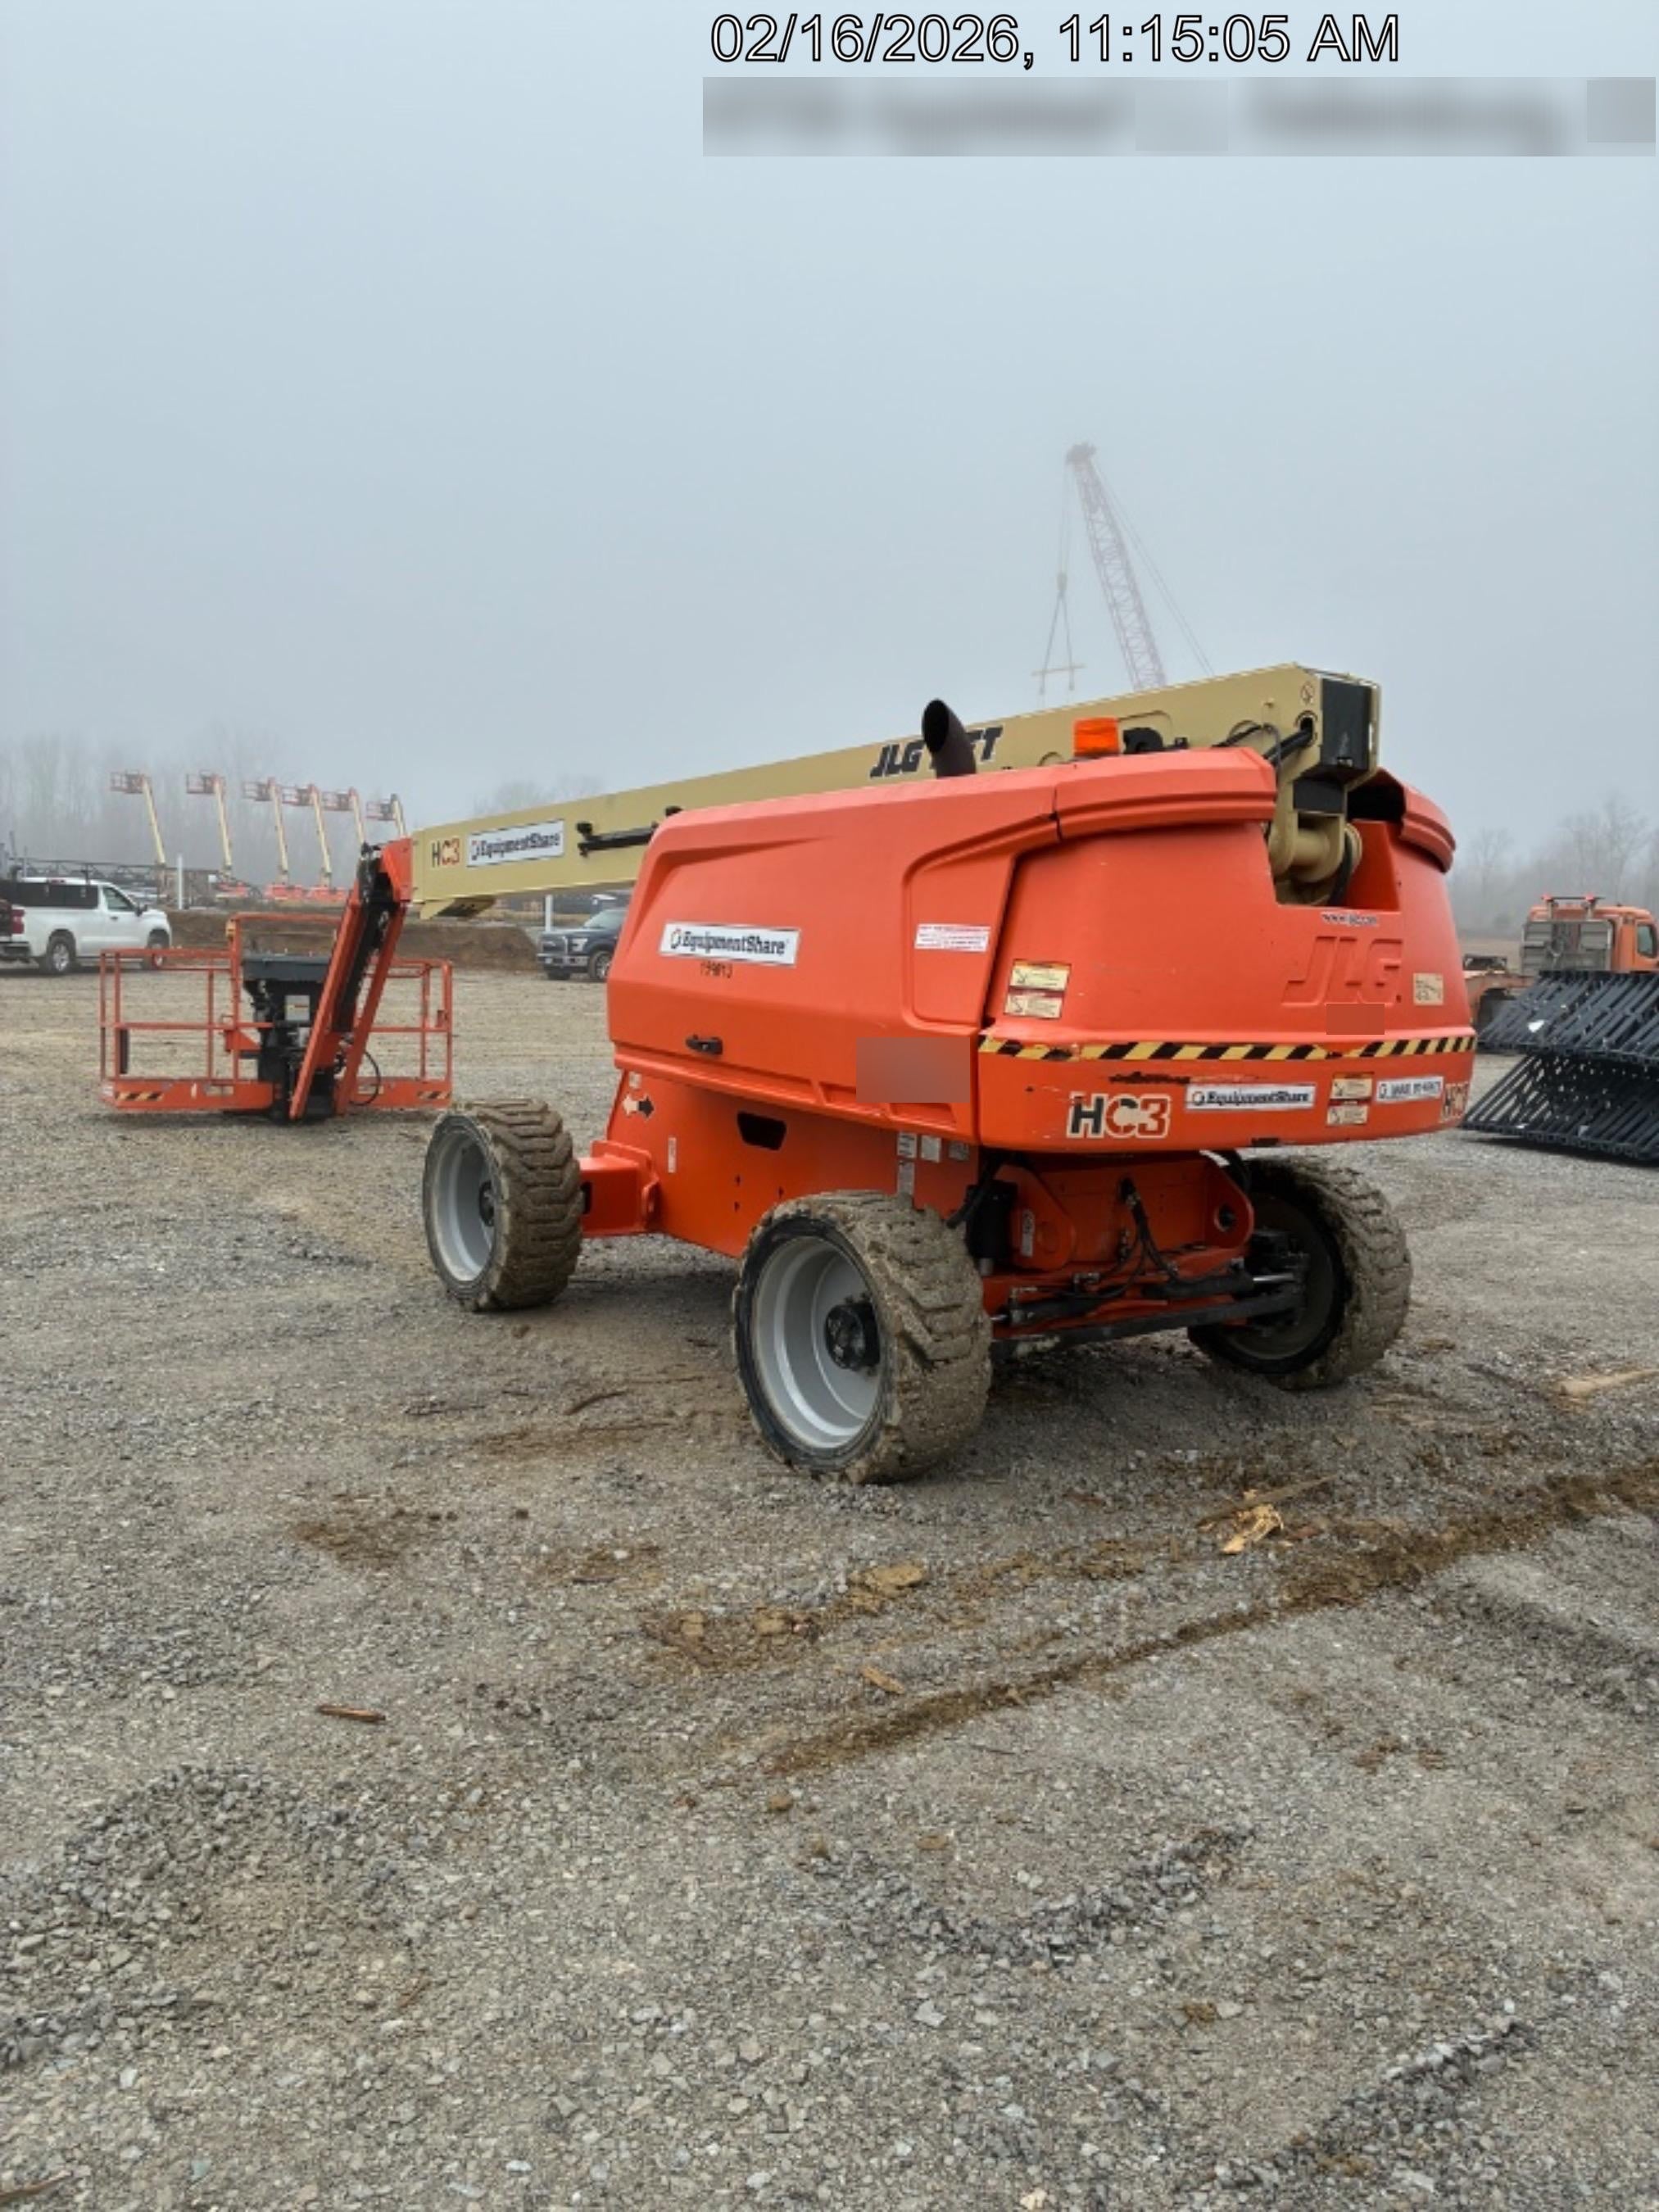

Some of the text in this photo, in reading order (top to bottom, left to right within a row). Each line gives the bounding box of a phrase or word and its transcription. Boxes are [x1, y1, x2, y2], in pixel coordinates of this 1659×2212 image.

[870, 740, 926, 778] JLG
[432, 837, 460, 868] HC3
[480, 832, 560, 859] EquipmentShare
[682, 931, 786, 955] EquipmentShare
[1206, 1090, 1310, 1105] EquipmentShare
[1067, 1095, 1169, 1137] HC3
